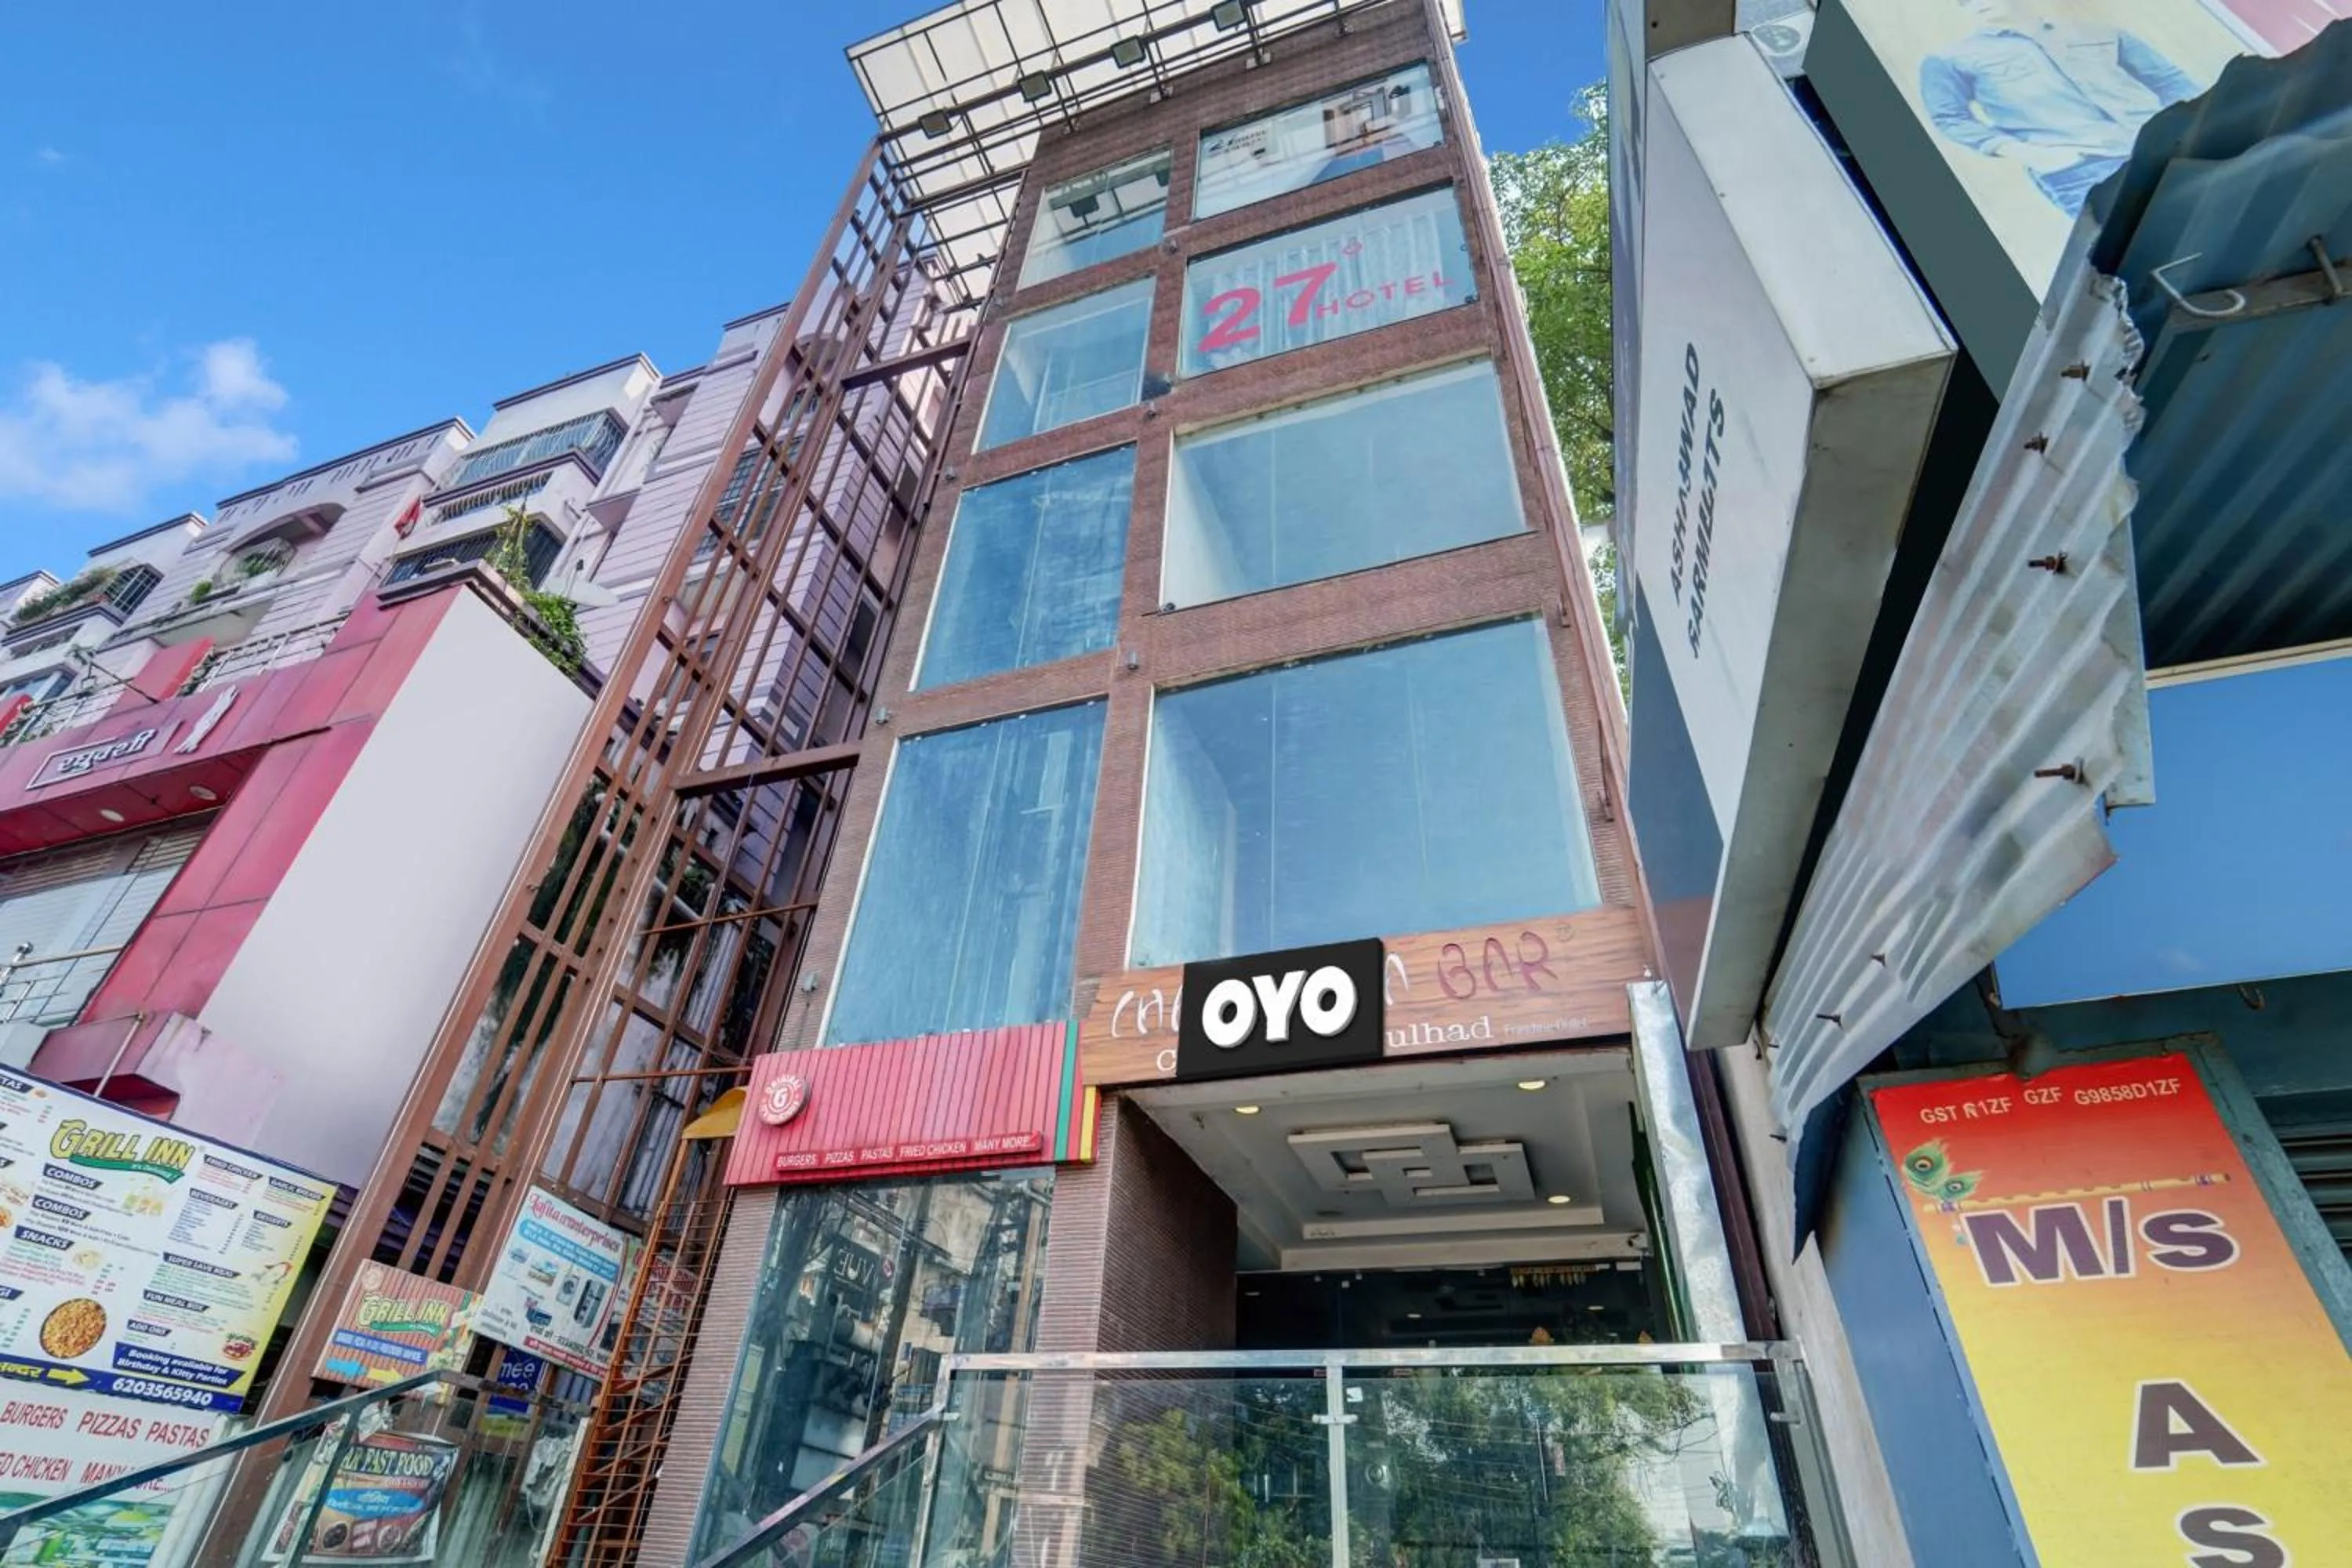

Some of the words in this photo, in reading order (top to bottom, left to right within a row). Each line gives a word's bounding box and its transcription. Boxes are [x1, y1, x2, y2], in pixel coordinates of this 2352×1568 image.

[1316, 271, 1455, 319] HOTEL
[1202, 965, 1357, 1048] OYO
[1385, 1016, 1493, 1048] ulhad
[0, 1075, 23, 1091] TAS
[1920, 1105, 1958, 1124] GST
[2023, 1087, 2063, 1105] GZF
[50, 1119, 141, 1160] GRILL
[141, 1137, 197, 1171] INN
[777, 1153, 816, 1167] BURGERS
[826, 1150, 855, 1163] PIZZAS
[862, 1146, 893, 1160] PASTAS
[900, 1145, 925, 1157] FRIED
[927, 1142, 967, 1156] CHICKEN
[974, 1138, 1000, 1152] MANY
[46, 1167, 96, 1189] COMBOS
[34, 1198, 85, 1219] COMBOS
[21, 1230, 69, 1249] SNACKS
[168, 1254, 194, 1269] SUPER
[358, 1294, 416, 1327] GRILL
[415, 1299, 454, 1324] INN
[117, 1357, 161, 1374] Birthday
[195, 1373, 229, 1385] Parties
[129, 1349, 170, 1365] Booking
[112, 1377, 213, 1406] 6203565940
[0, 1400, 68, 1429] BURGERS
[76, 1410, 142, 1439] PIZZAS
[145, 1421, 212, 1448] PASTAS
[12, 1454, 74, 1481] CHICKEN
[361, 1447, 397, 1475] FAST
[395, 1451, 434, 1476] FOOD
